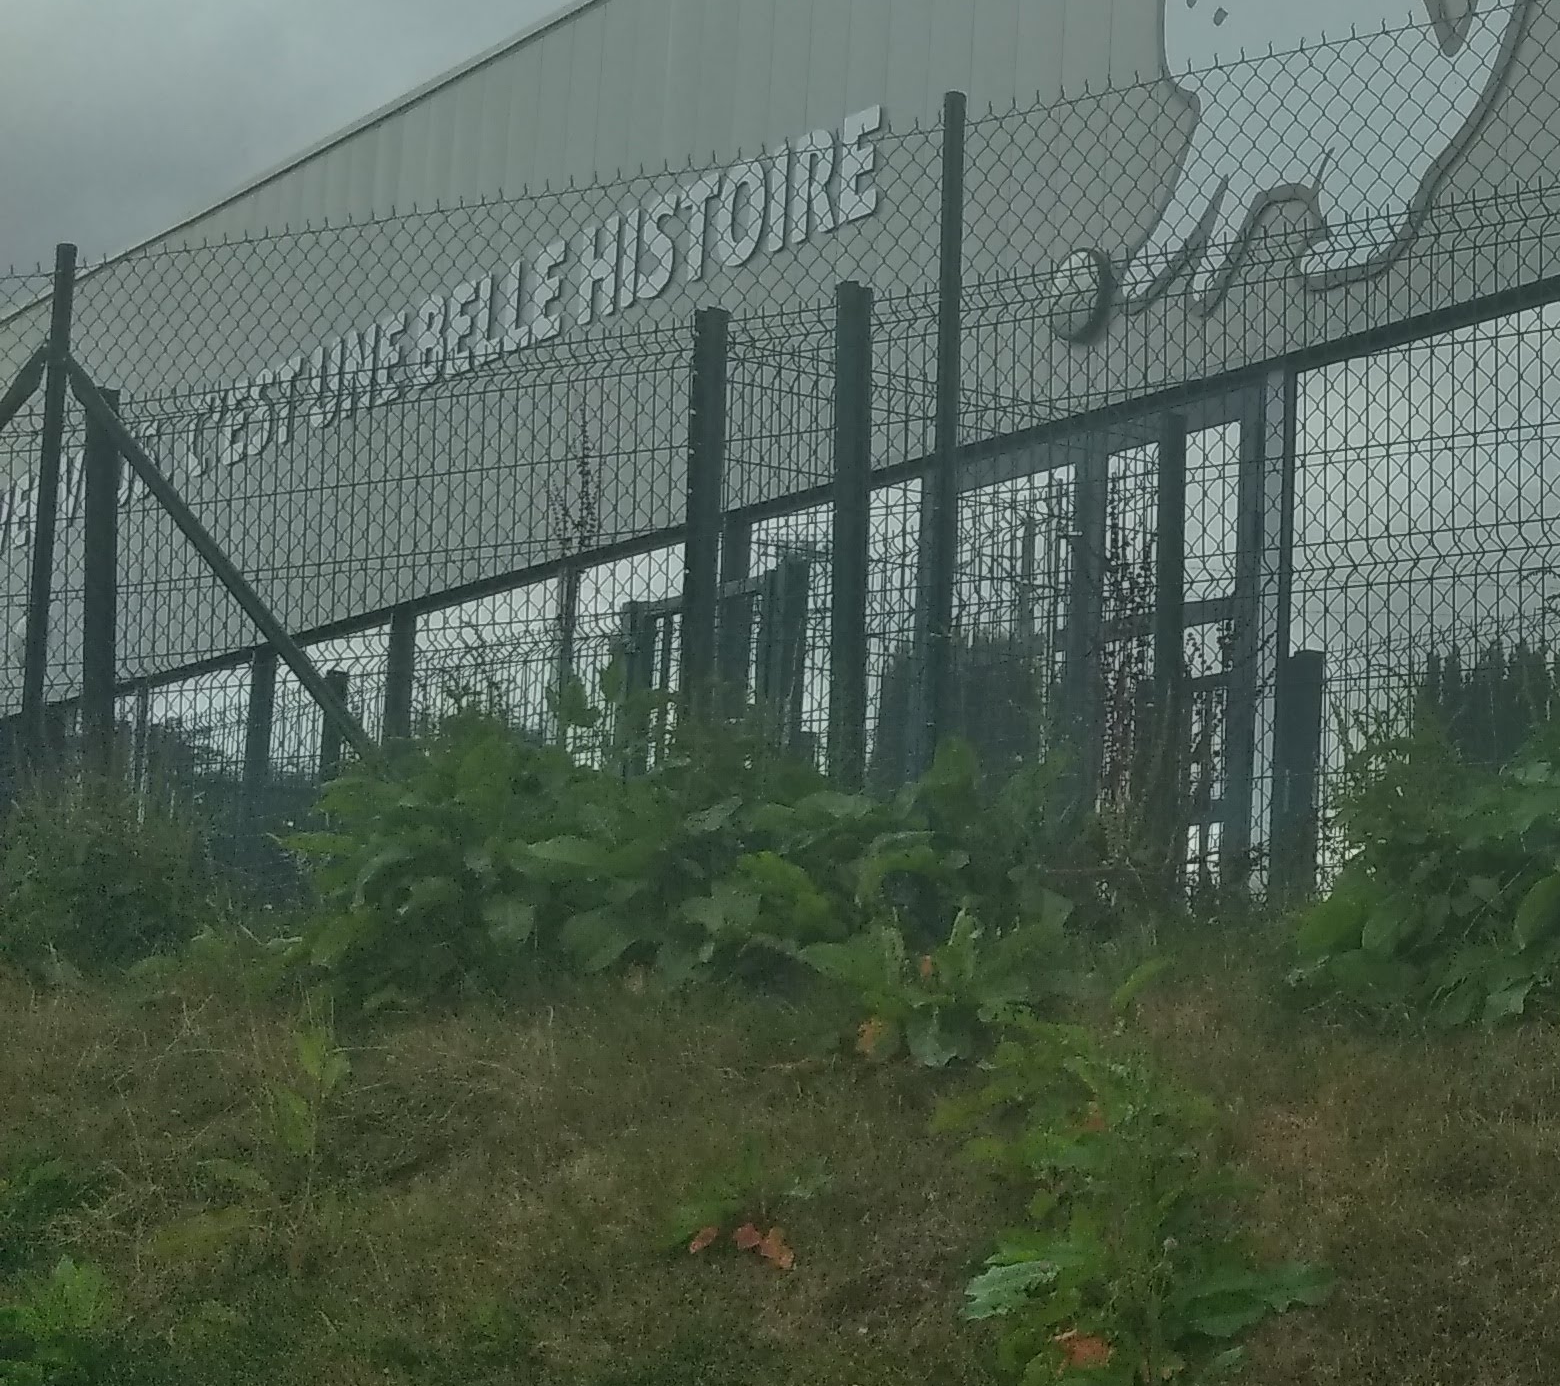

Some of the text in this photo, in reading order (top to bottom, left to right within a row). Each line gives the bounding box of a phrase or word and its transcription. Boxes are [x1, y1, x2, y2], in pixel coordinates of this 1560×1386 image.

[307, 310, 405, 428] UNE
[413, 239, 566, 385] BELLE
[576, 104, 880, 325] HISTOIRE
